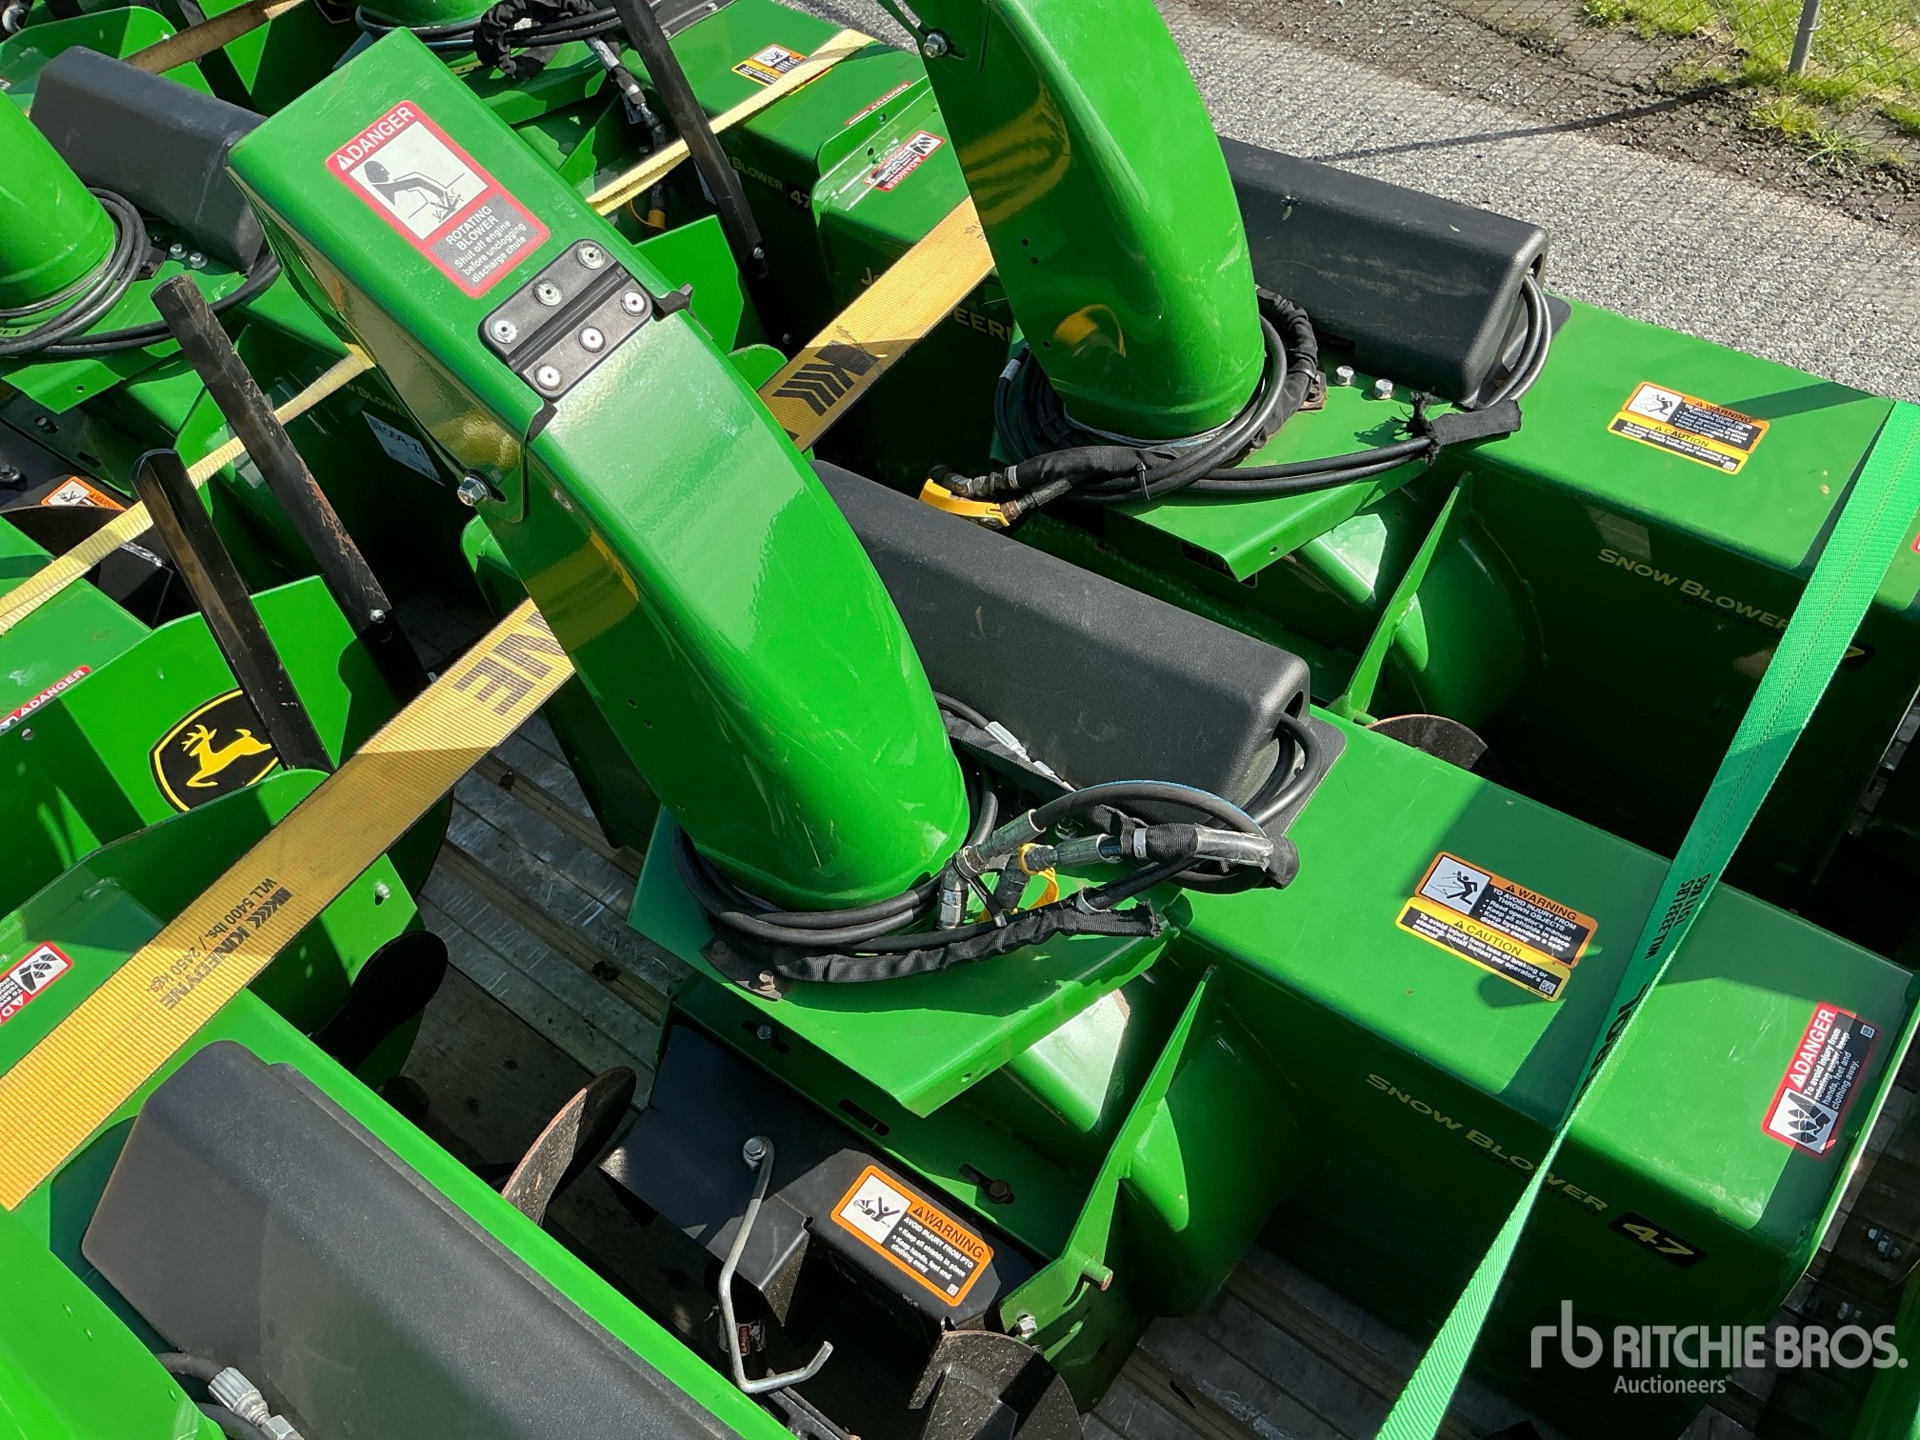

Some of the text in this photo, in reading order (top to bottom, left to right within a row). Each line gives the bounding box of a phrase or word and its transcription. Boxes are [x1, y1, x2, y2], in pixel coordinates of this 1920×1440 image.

[346, 106, 415, 160] DANGER
[885, 160, 919, 188] DANGER
[445, 205, 492, 245] ROTATING
[454, 220, 512, 268] Shut off engine
[456, 215, 499, 250] BLOWER
[463, 222, 527, 276] before unclogging
[472, 235, 527, 283] discharge chute
[1706, 404, 1753, 423] WARNING
[1664, 429, 1709, 447] CAUTION
[1598, 548, 1679, 586] SNOW
[28, 670, 86, 708] DANGER
[250, 878, 278, 899] WLL
[1518, 887, 1577, 920] WARNING
[1689, 873, 1711, 898] KGS
[205, 922, 229, 939] lbs.
[224, 897, 255, 925] 5400
[1480, 916, 1529, 942] distance away
[1487, 906, 1505, 917] Keep
[1515, 918, 1541, 934] shields
[1541, 930, 1549, 938] in
[1549, 935, 1570, 948] place
[1490, 900, 1572, 941] Read operator's manual
[1498, 897, 1566, 931] THROWN OBJECTS
[1504, 892, 1526, 906] AVOID
[1527, 902, 1554, 918] INJURY
[1554, 915, 1577, 930] FROM
[1645, 880, 1695, 960] WLL 3333 LBS
[1412, 925, 1438, 939] manual
[1420, 913, 1428, 921] To
[1428, 917, 1448, 931] avoid
[1448, 926, 1469, 942] injury
[1469, 937, 1486, 948] from
[1486, 944, 1502, 955] loss
[1502, 952, 1511, 961] of
[1510, 955, 1538, 975] braking
[1467, 925, 1522, 956] CAUTION
[1484, 911, 1502, 923] Keep
[1502, 919, 1541, 942] bystanders
[1547, 940, 1564, 951] safe
[160, 926, 250, 1010] KINEDYNE
[171, 947, 200, 976] 2450
[1491, 955, 1505, 965] per
[1505, 962, 1541, 982] operator's
[147, 973, 173, 993] kgs.
[1794, 1009, 1836, 1080] DANGER
[1804, 1028, 1841, 1096] To avoid injury from
[1814, 1031, 1851, 1101] rotating auger, keep
[1822, 1051, 1852, 1105] hands, feet and
[1832, 1060, 1860, 1110] clothing away.
[1366, 1073, 1463, 1130] SNOW
[902, 1228, 966, 1277] Keep all shields in place
[904, 1217, 974, 1269] AVOID INJURY FROM PTO
[924, 1210, 984, 1259] WARNING
[1622, 1222, 1695, 1256] 47
[891, 1244, 929, 1273] clothing away
[896, 1237, 952, 1280] Keep hands, feet and
